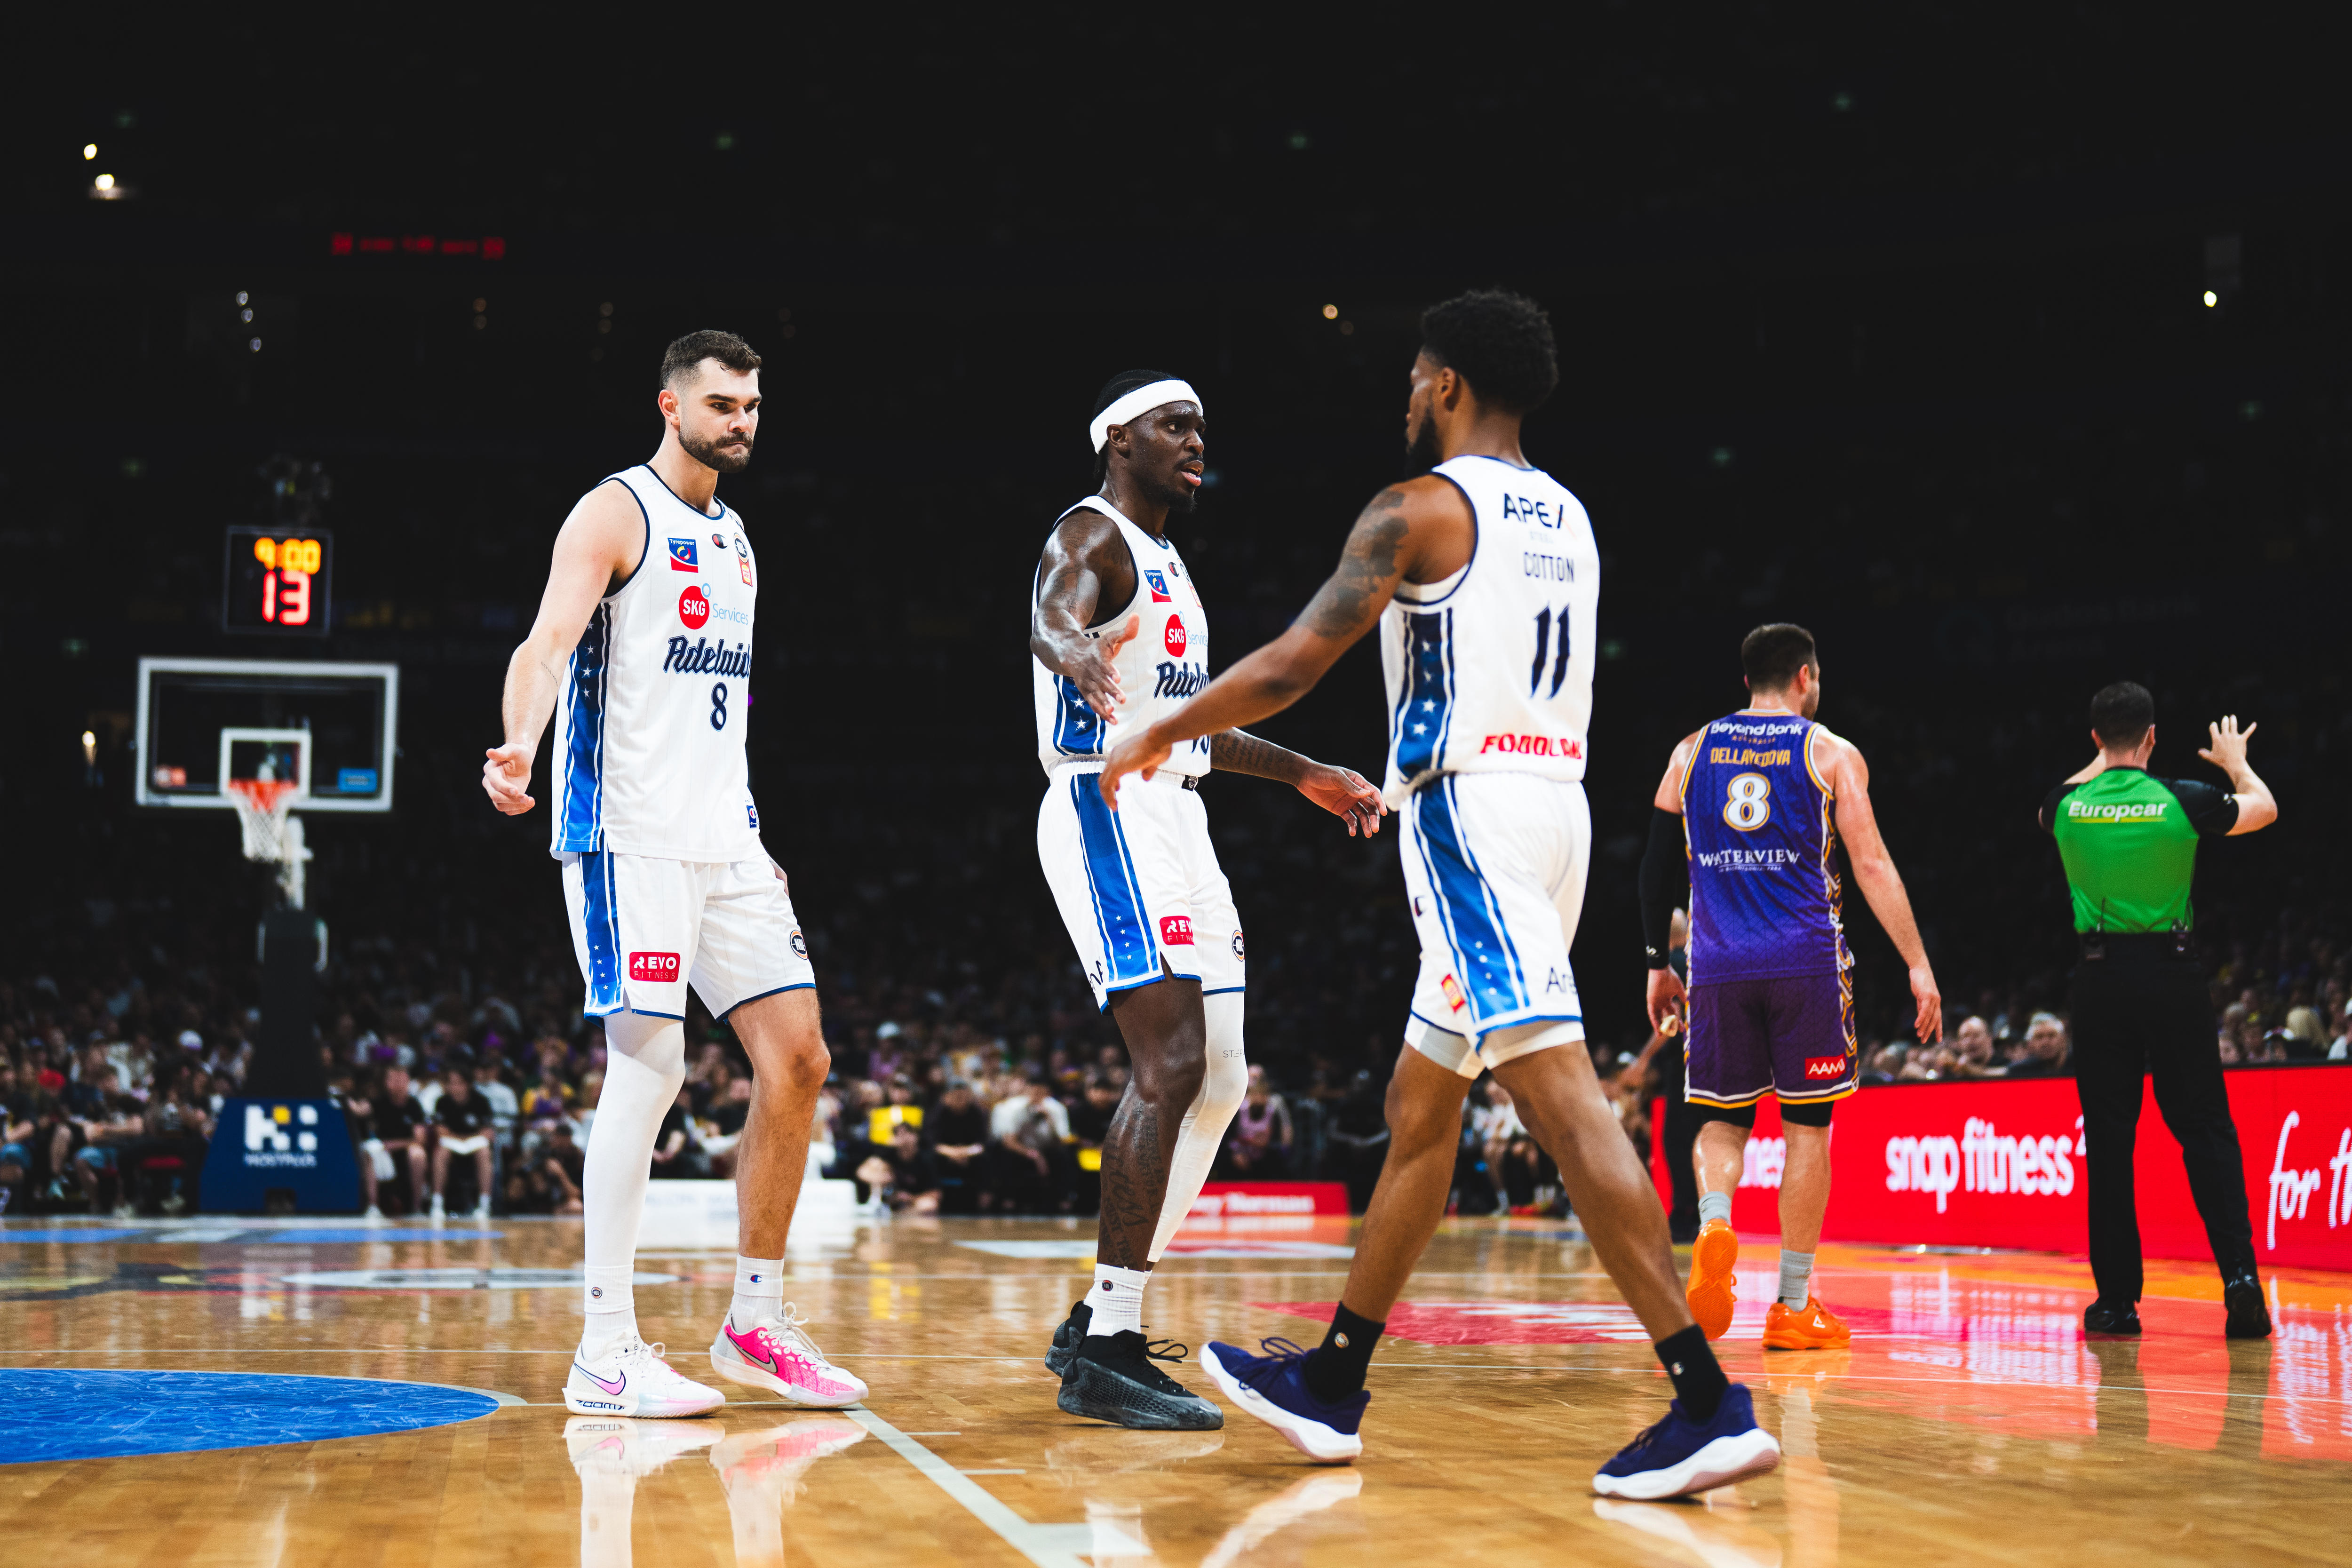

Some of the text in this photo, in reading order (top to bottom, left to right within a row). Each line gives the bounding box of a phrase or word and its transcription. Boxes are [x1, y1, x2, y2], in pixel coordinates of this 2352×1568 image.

[1524, 551, 1574, 582] COTTON
[262, 570, 310, 625] 13
[683, 599, 749, 625] SKG Services
[1168, 628, 1184, 644] SKG
[1530, 600, 1570, 700] 11
[710, 682, 728, 732] 8
[1711, 723, 1804, 736] Beyond Bank
[1723, 772, 1771, 831] 8
[2068, 801, 2167, 822] Europcar
[1698, 849, 1800, 867] WATERVIEW
[1167, 920, 1192, 933] REV
[634, 956, 676, 969] REVO
[1886, 1135, 1960, 1214] snap
[1961, 1116, 2074, 1196] fitness
[2266, 1109, 2321, 1250] for
